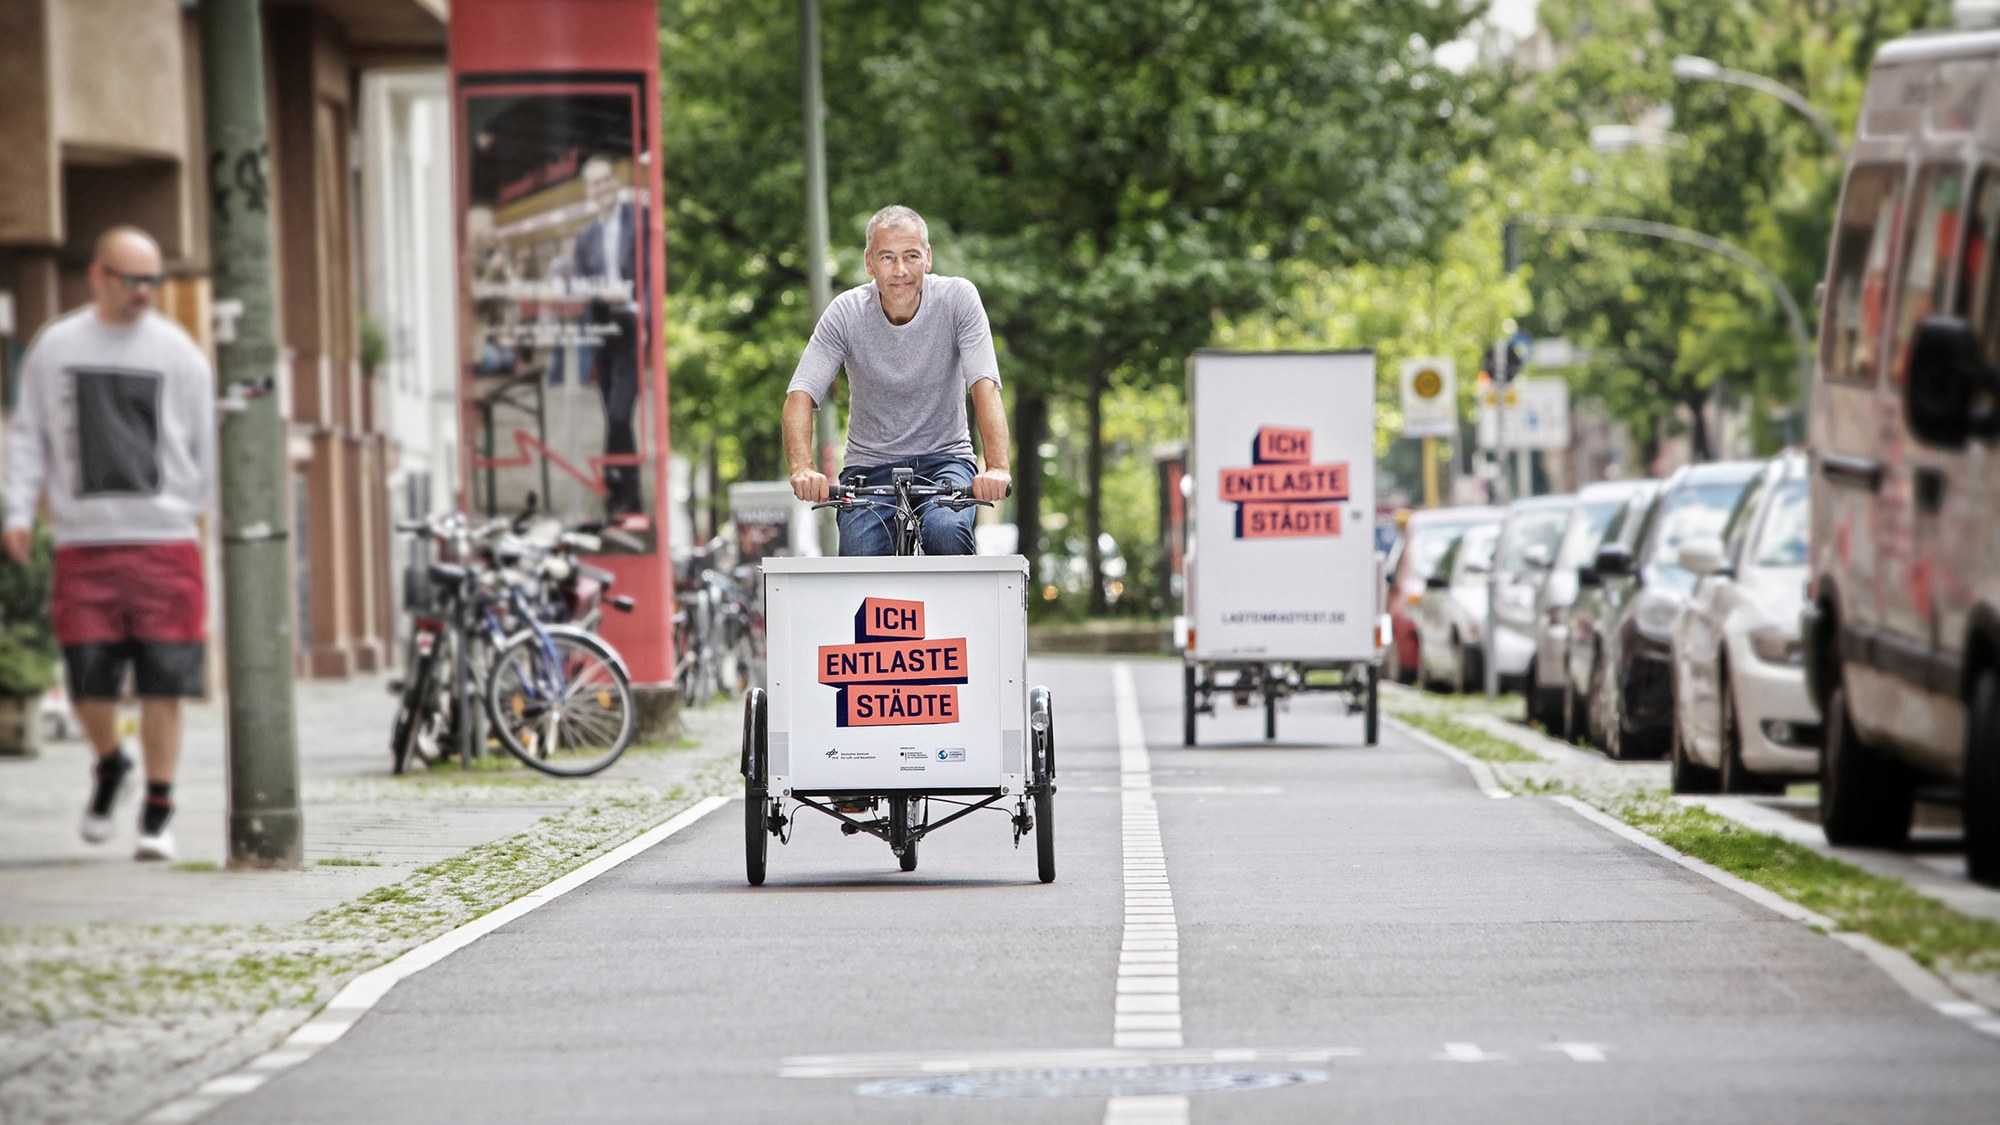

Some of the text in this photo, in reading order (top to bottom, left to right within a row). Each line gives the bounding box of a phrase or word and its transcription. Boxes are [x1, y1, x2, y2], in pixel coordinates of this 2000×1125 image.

[1268, 433, 1307, 454] ICH
[1224, 469, 1341, 494] ENTLASTE
[1251, 506, 1335, 532] STÄDTE
[875, 607, 917, 630] ICH
[826, 647, 959, 676] ENTLASTE
[856, 688, 953, 718] STÄDTE
